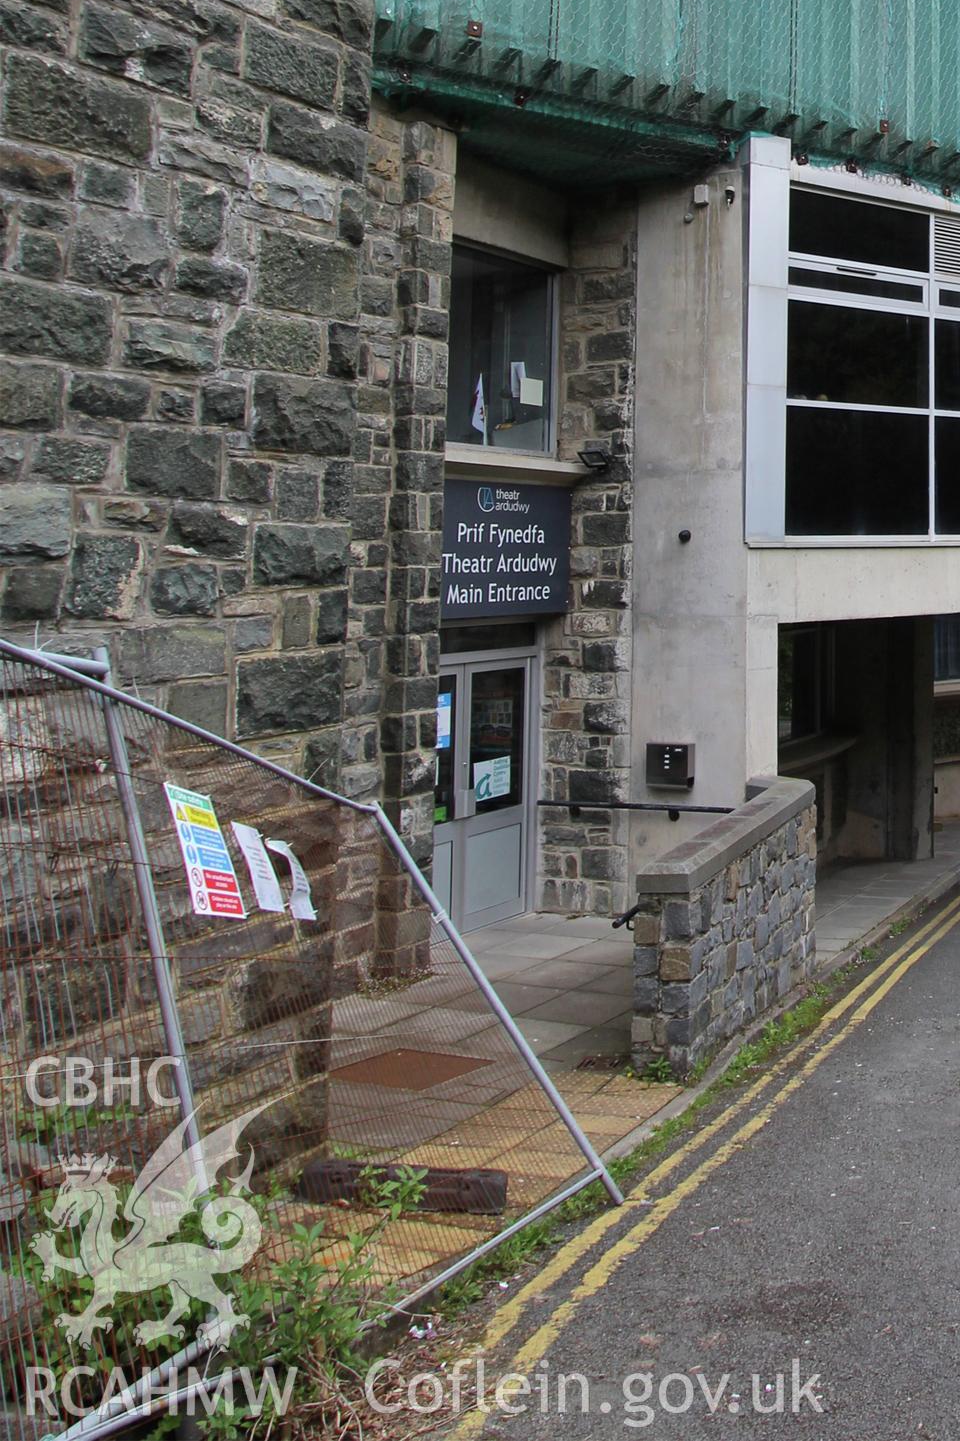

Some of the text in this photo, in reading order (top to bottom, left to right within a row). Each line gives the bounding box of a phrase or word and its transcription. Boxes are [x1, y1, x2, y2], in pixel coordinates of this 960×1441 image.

[496, 489, 520, 500] theatr
[495, 502, 530, 513] ardudwy
[457, 522, 545, 548] Prif Fynedfa
[442, 553, 557, 576] Theatr Ardudwy
[447, 583, 551, 604] Main Entrance
